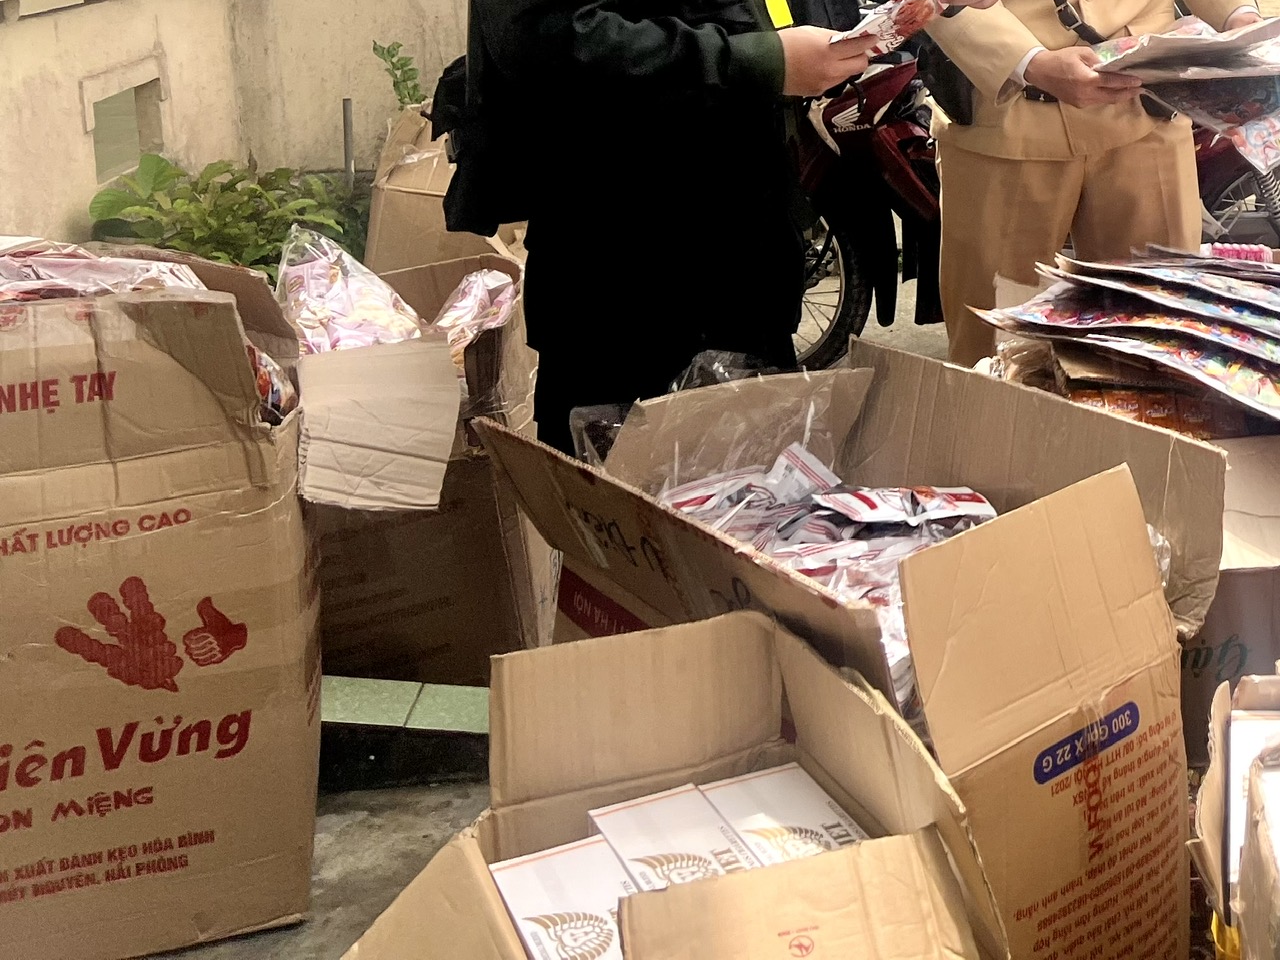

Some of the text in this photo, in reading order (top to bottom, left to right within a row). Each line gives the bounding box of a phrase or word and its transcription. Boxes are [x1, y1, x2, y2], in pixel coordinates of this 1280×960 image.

[833, 123, 871, 134] HONDA
[0, 371, 117, 414] NHẸ TAY
[46, 519, 130, 549] LƯỢNG
[137, 508, 192, 533] CAO
[1112, 710, 1132, 734] 300
[1042, 756, 1053, 773] G
[1056, 744, 1071, 765] 22
[51, 786, 154, 822] MIỆNG
[107, 844, 138, 865] KẸO
[135, 854, 189, 877] PHÒNG
